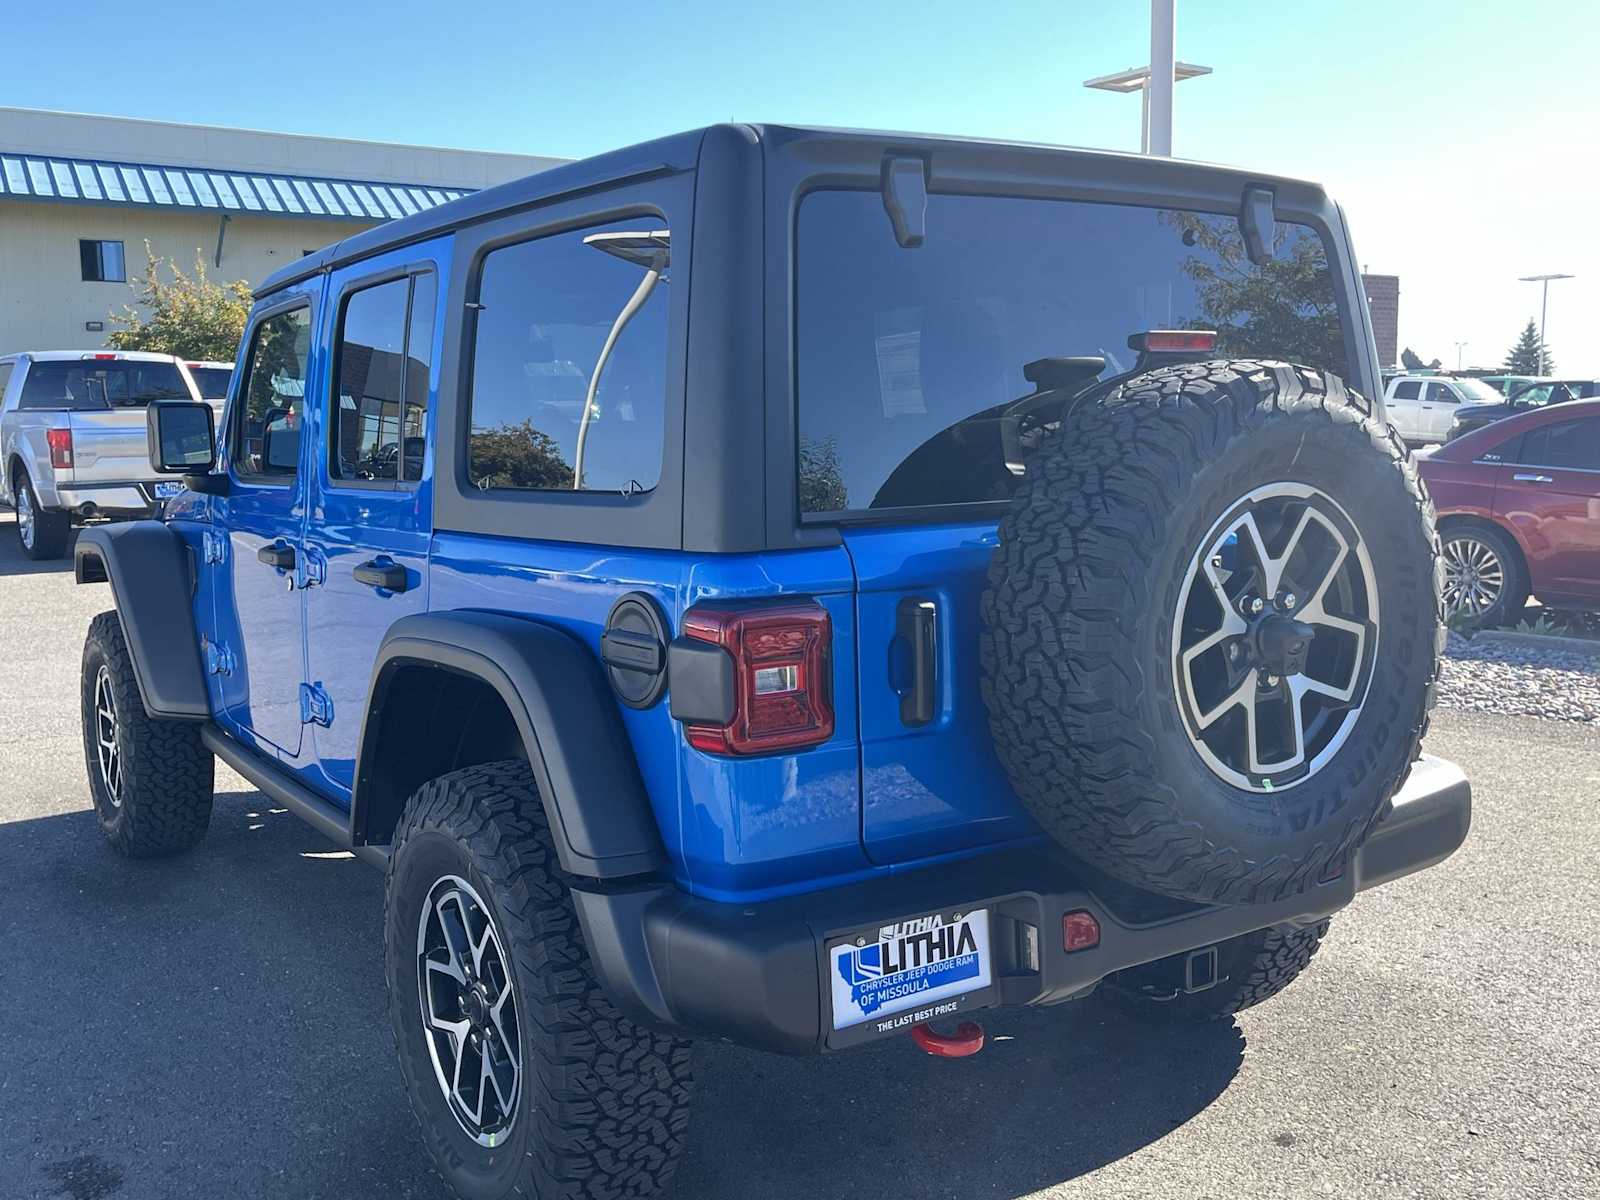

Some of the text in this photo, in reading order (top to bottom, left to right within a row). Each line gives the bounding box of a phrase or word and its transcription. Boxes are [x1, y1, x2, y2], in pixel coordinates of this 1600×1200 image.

[893, 914, 943, 941] LITHIA
[882, 922, 977, 975] LITHIA
[860, 954, 974, 994] CHRYSLER JEEP DODGE RAM
[860, 979, 929, 1007] OF MISSOULA
[877, 1001, 957, 1032] THE LAST BEST PRICE
